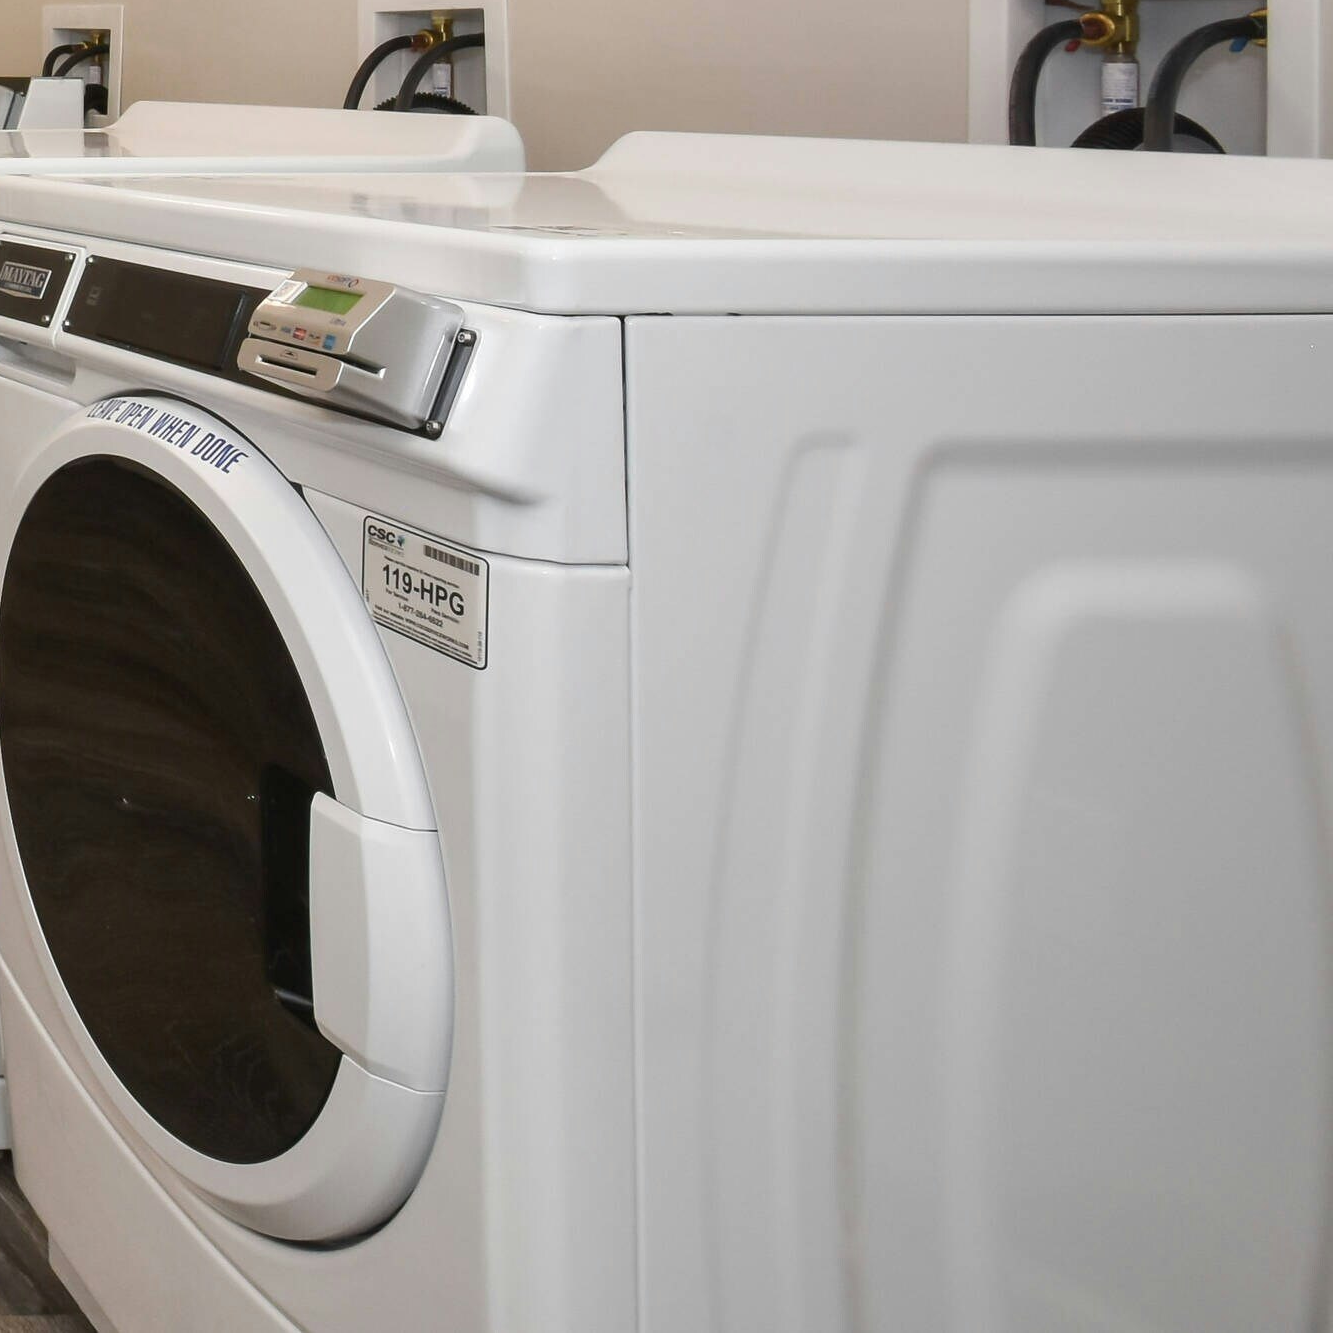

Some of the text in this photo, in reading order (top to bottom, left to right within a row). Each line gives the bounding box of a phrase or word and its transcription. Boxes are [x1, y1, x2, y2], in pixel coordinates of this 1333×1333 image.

[0, 266, 46, 288] MAYTAG
[115, 402, 159, 430] OPEN
[147, 412, 202, 449] WHEN
[190, 432, 249, 474] DONE
[367, 525, 396, 543] CSC
[382, 564, 465, 616] 119-HPG
